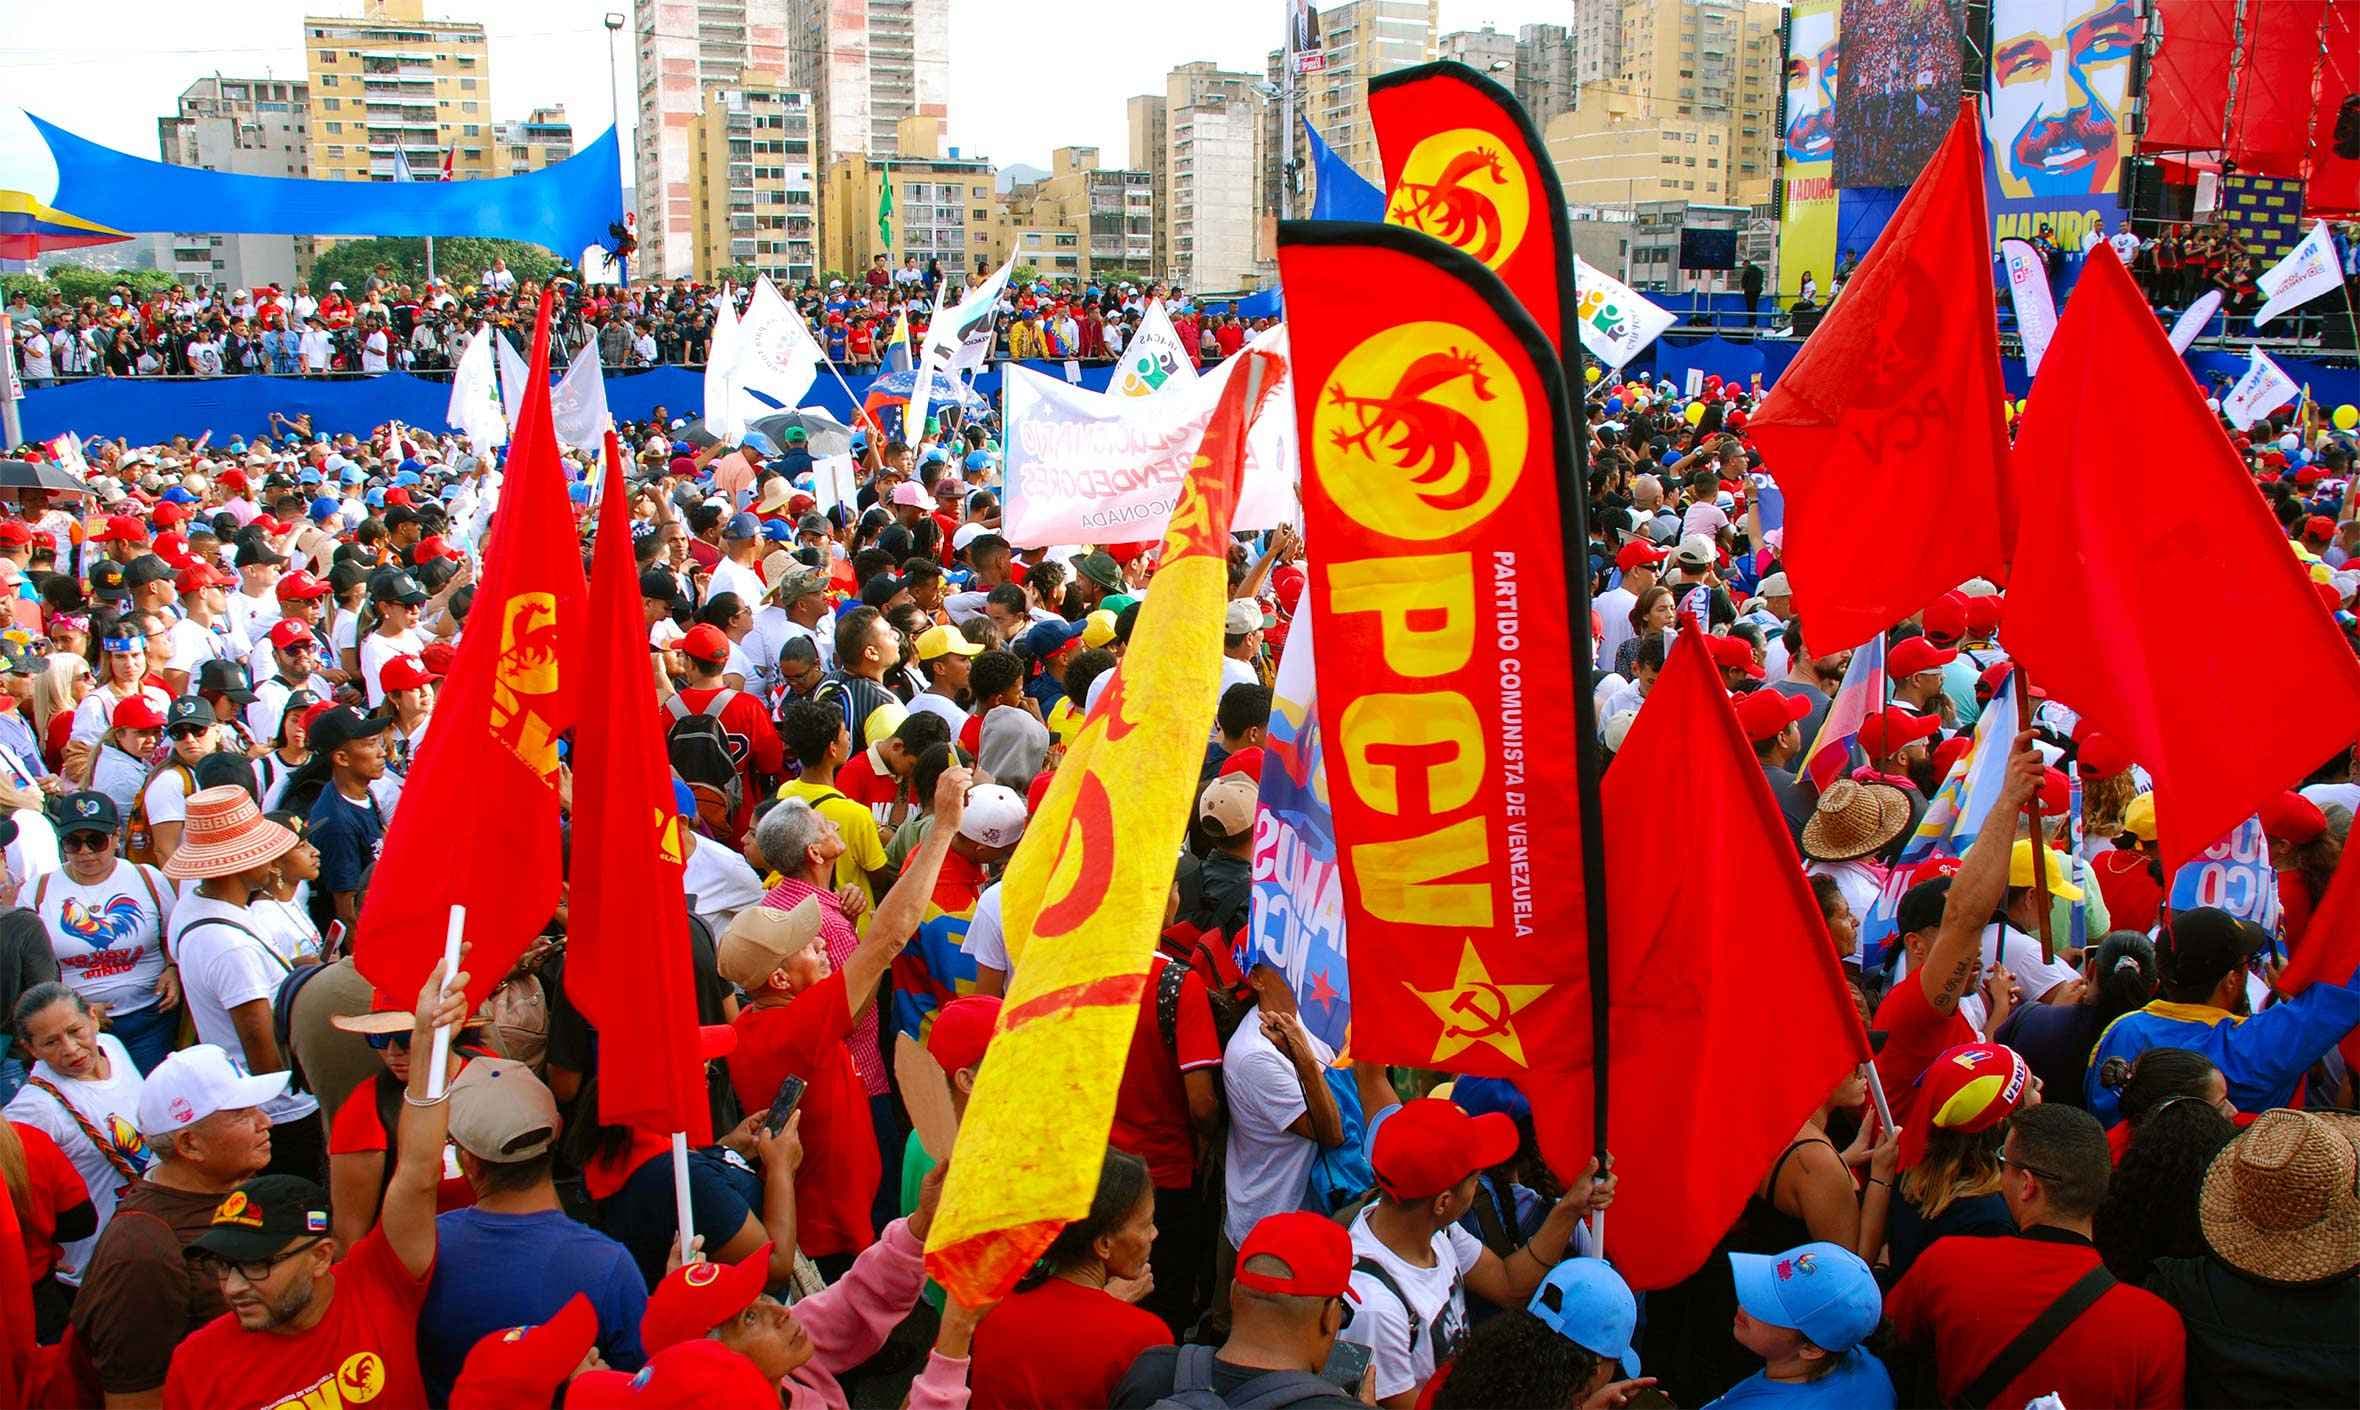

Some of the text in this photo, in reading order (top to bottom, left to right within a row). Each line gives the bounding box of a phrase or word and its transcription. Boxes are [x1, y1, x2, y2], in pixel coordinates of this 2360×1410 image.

[1326, 551, 1494, 928] PCV
[1492, 551, 1534, 939] PARTIDO COMUNISTA DE VENEZUELA
